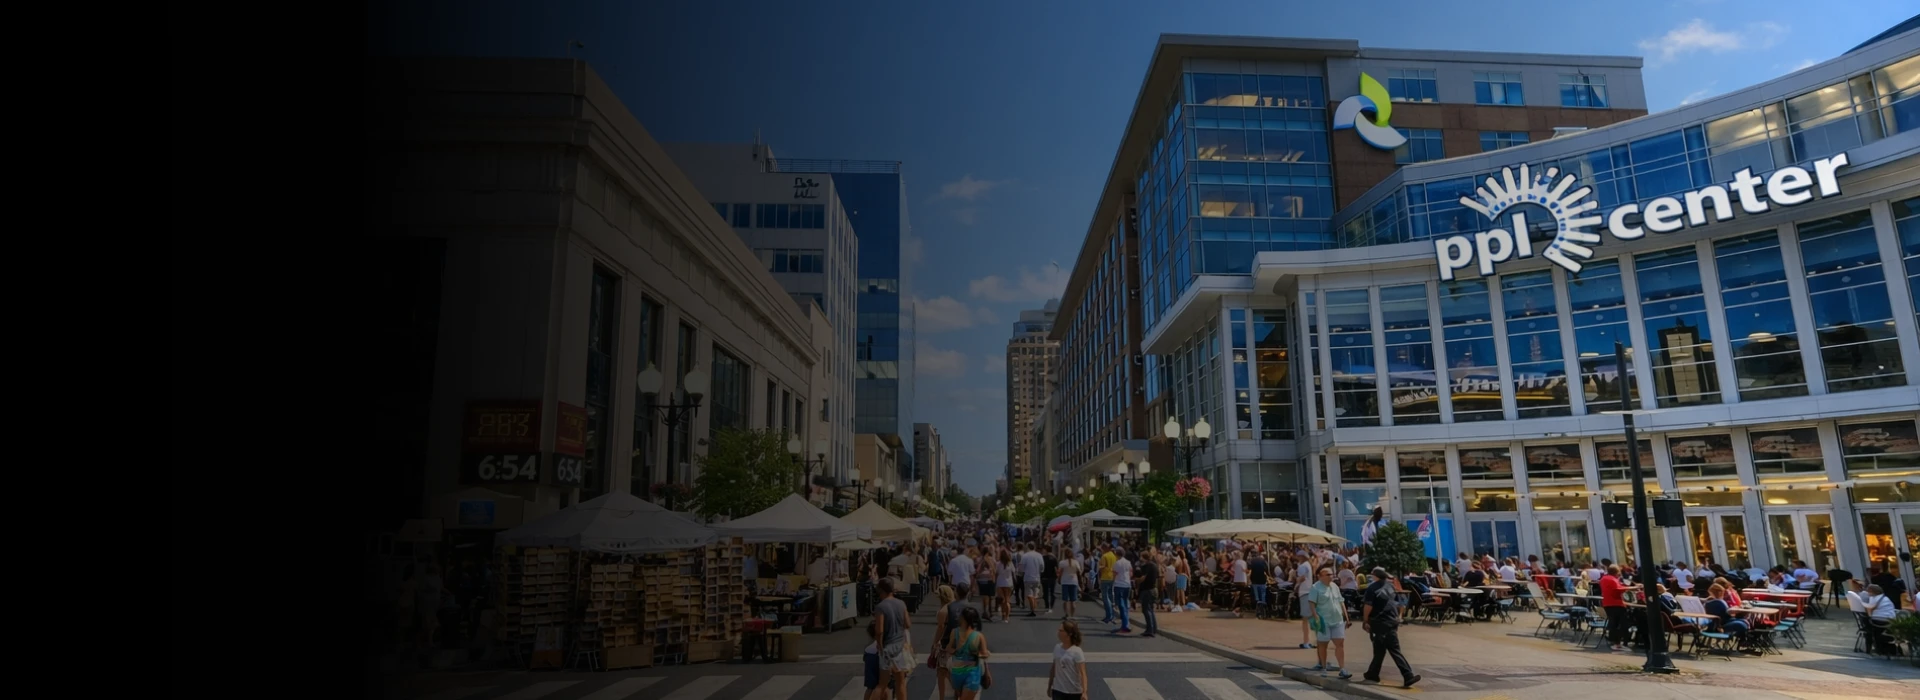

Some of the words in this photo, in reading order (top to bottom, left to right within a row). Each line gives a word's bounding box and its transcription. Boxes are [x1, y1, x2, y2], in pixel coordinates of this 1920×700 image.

[1435, 212, 1533, 281] ppl
[1607, 152, 1848, 240] center
[478, 454, 537, 481] 6:54
